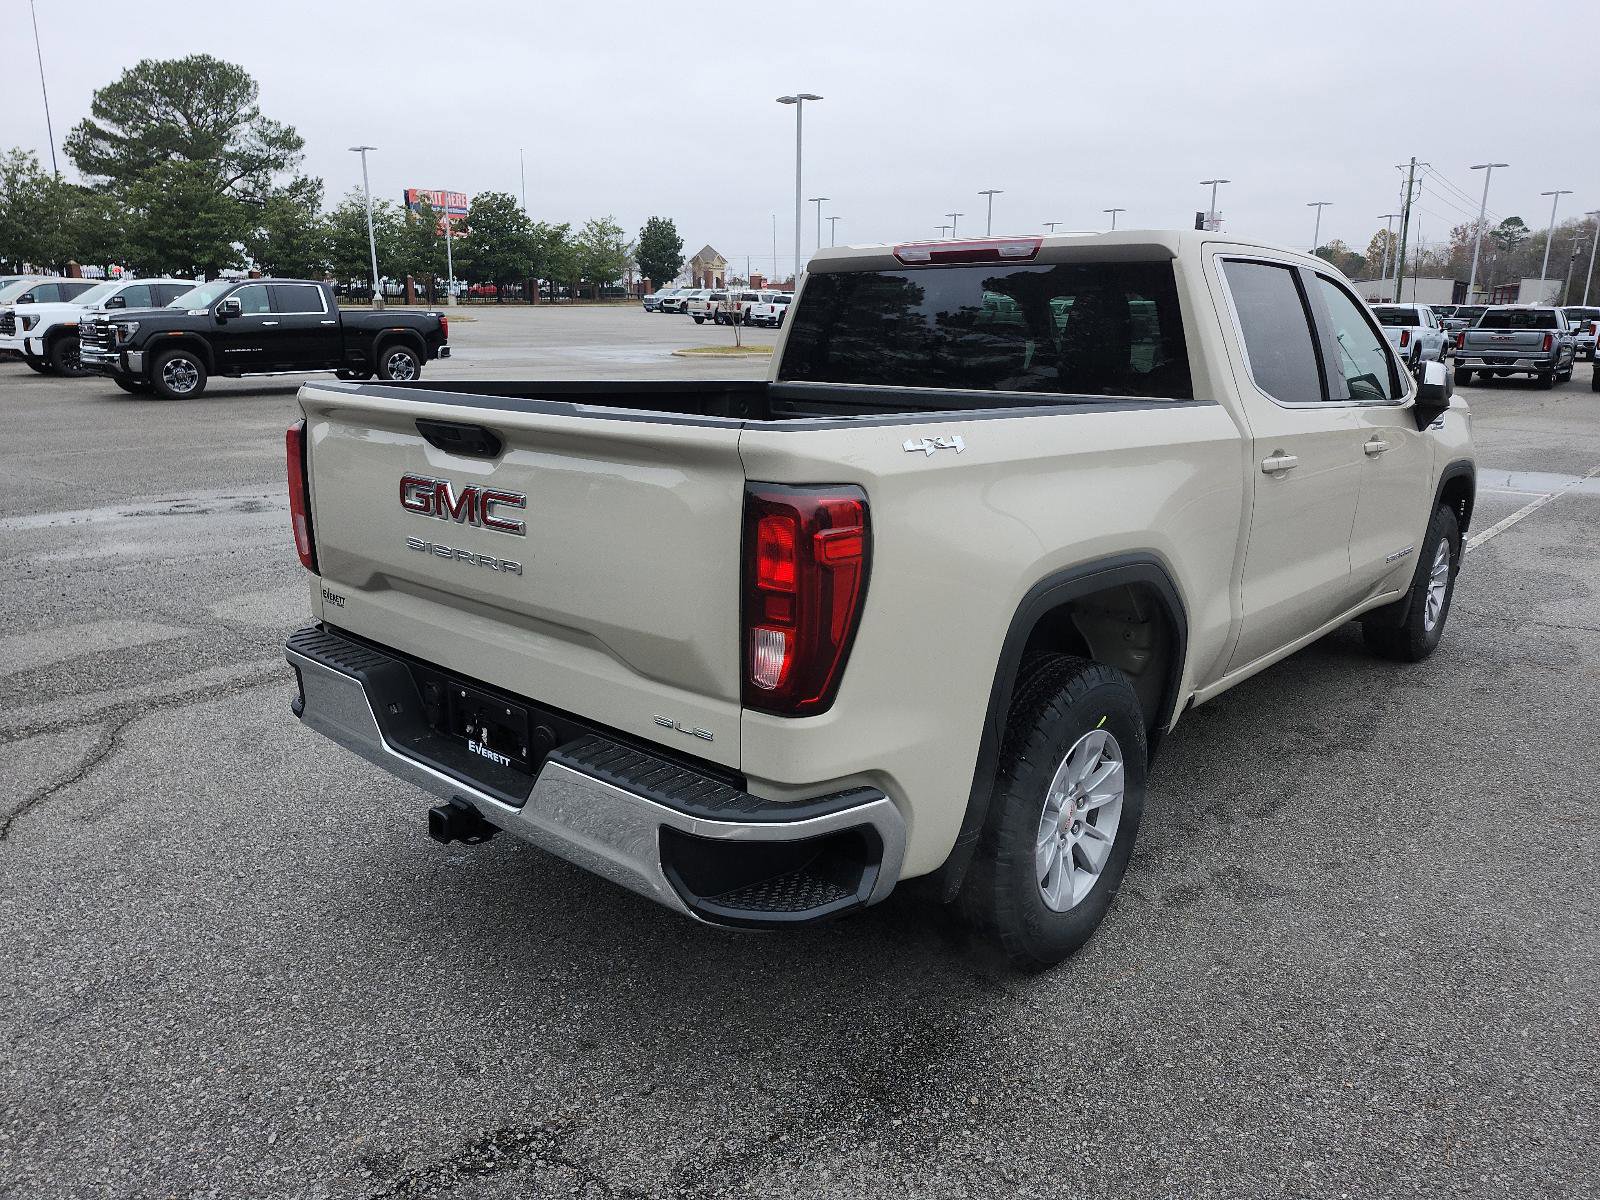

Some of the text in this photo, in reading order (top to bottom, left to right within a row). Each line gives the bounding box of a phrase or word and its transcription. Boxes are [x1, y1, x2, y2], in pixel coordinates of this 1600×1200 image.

[400, 472, 527, 538] GMC
[406, 536, 523, 576] SIERRA
[653, 714, 714, 741] SLE
[468, 740, 511, 767] EVERETT
